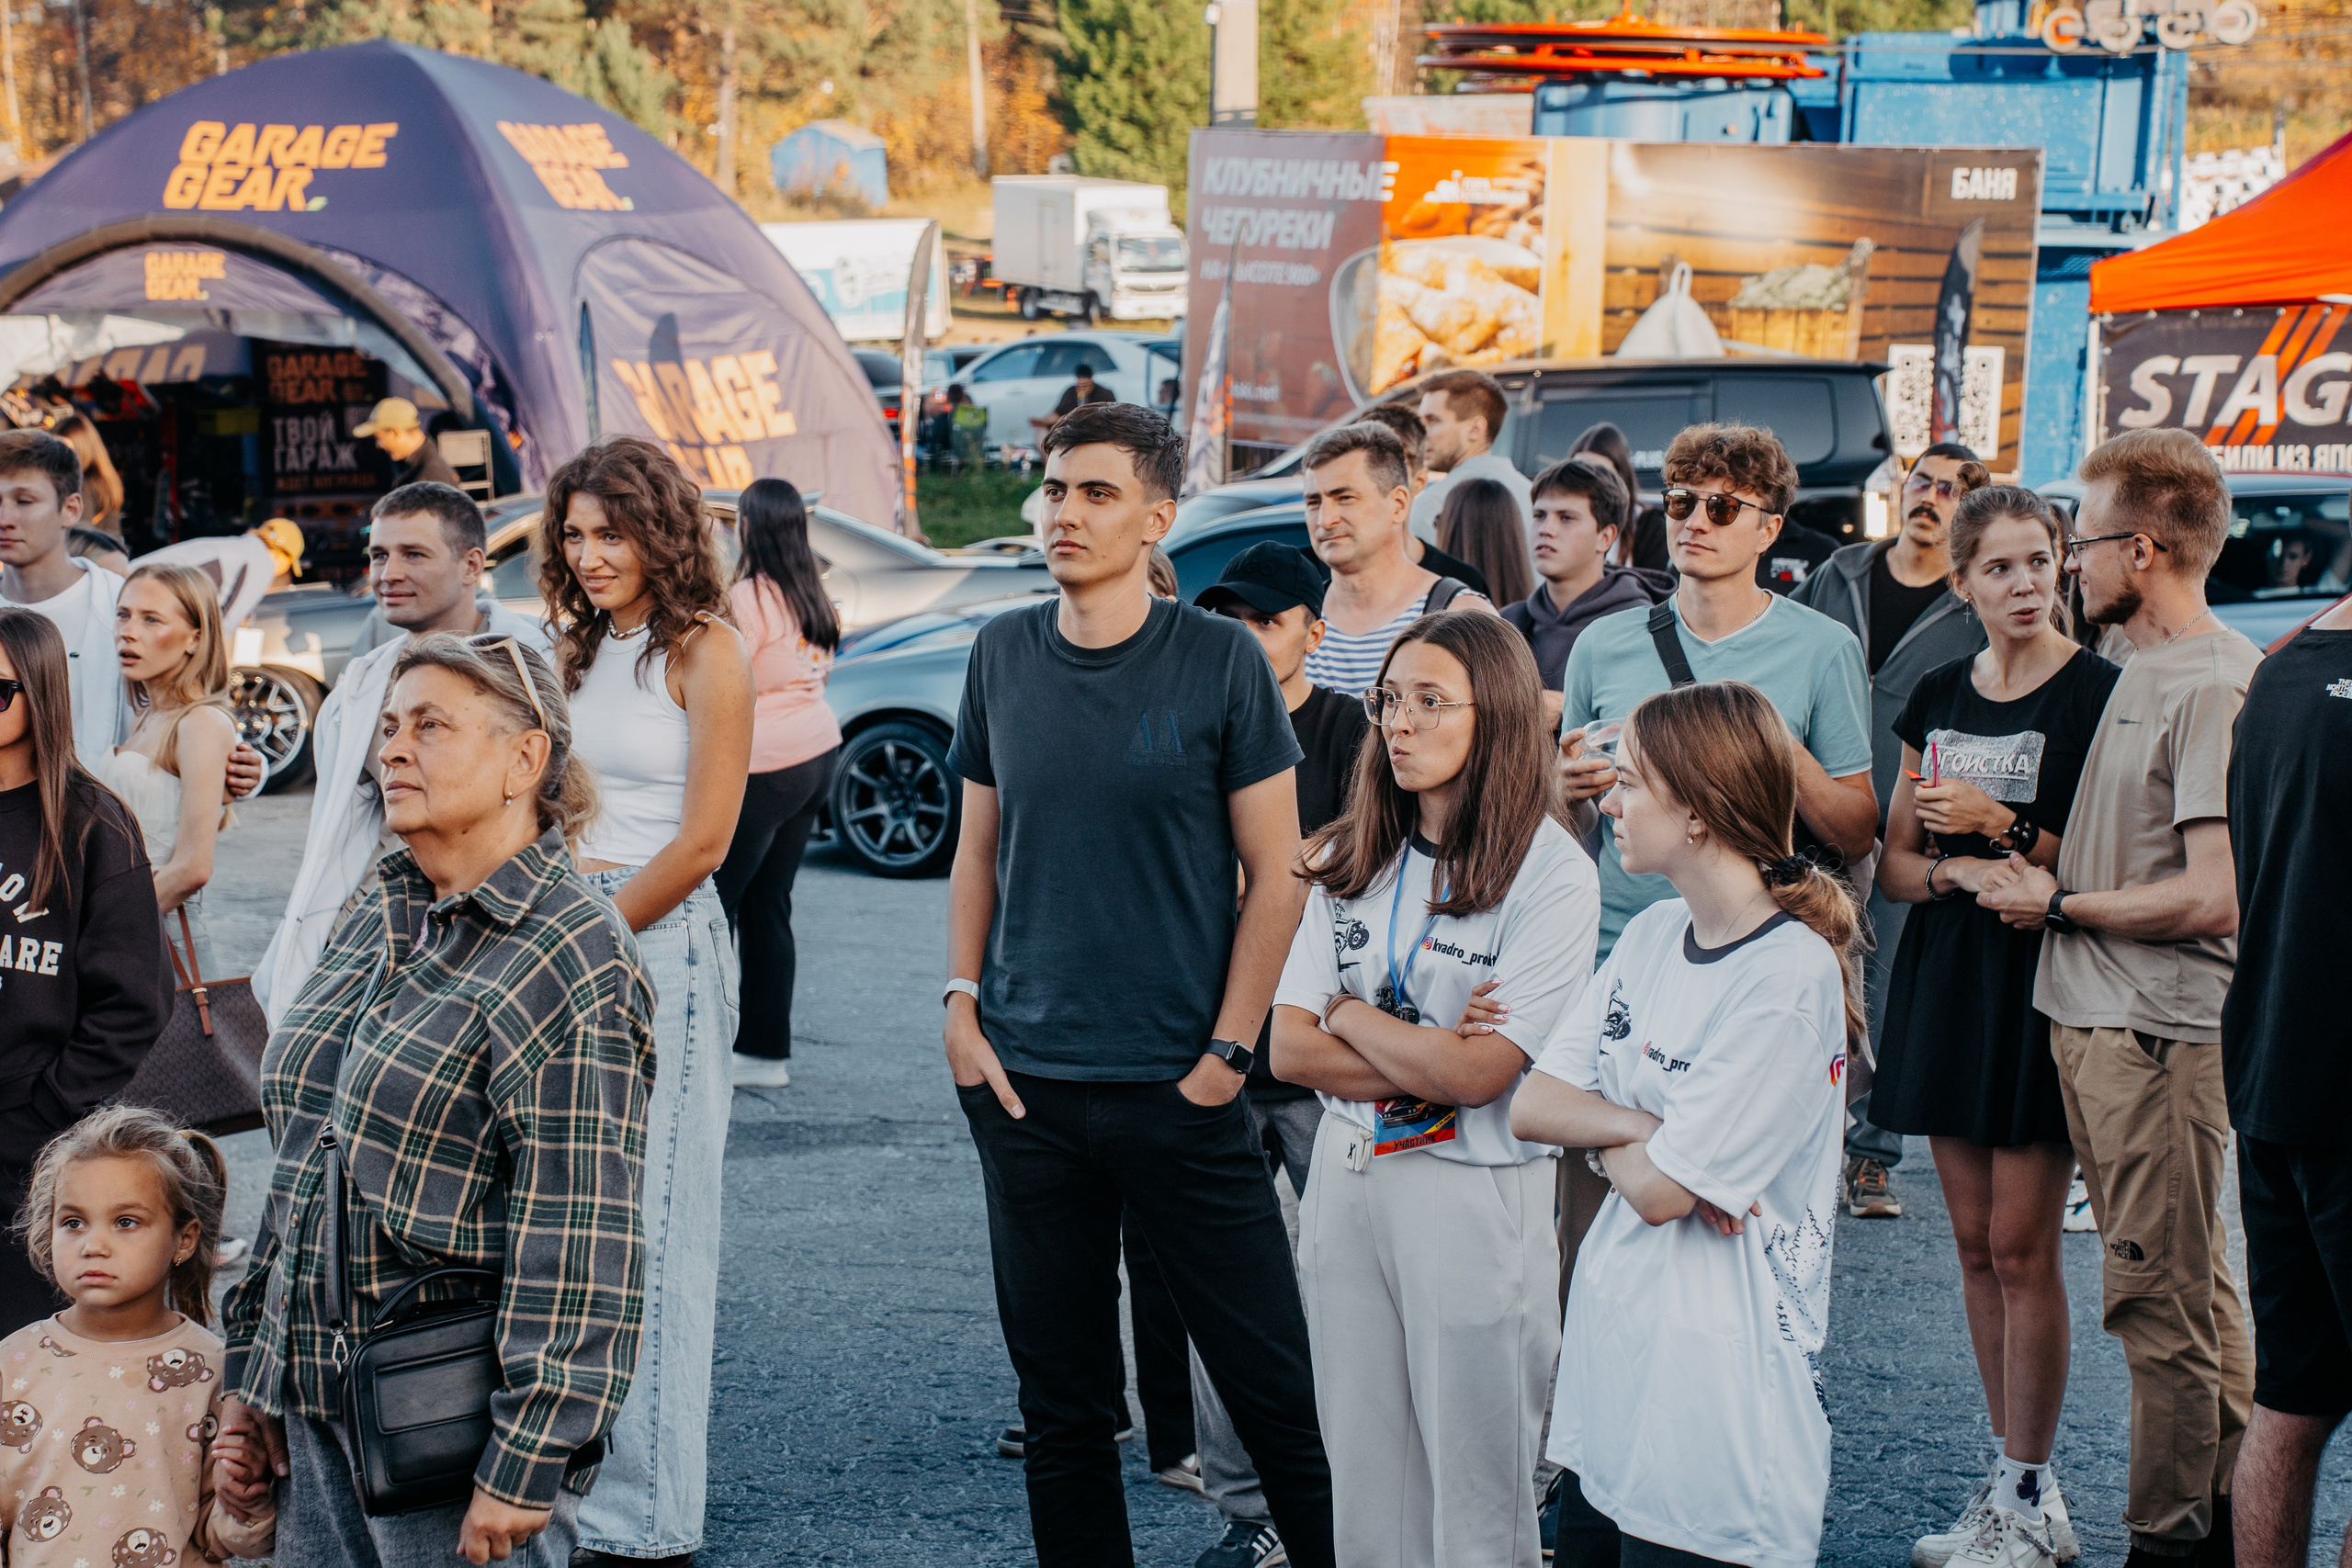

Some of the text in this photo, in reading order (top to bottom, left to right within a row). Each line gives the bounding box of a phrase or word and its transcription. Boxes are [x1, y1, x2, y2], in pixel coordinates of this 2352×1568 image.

[178, 120, 399, 169] GARAGE
[1200, 155, 1400, 202] КЛУБНИЧНЫЕ
[1951, 167, 2018, 200] БАНЯ
[2118, 351, 2352, 427] STAG
[273, 443, 358, 473] ГАРАЖ
[2277, 444, 2311, 472] ИЗ
[1393, 1133, 1437, 1152] УЧАСТНИК
[2109, 1242, 2131, 1254] NORTH
[2114, 1249, 2131, 1261] FACE
[2117, 1237, 2131, 1247] THE
